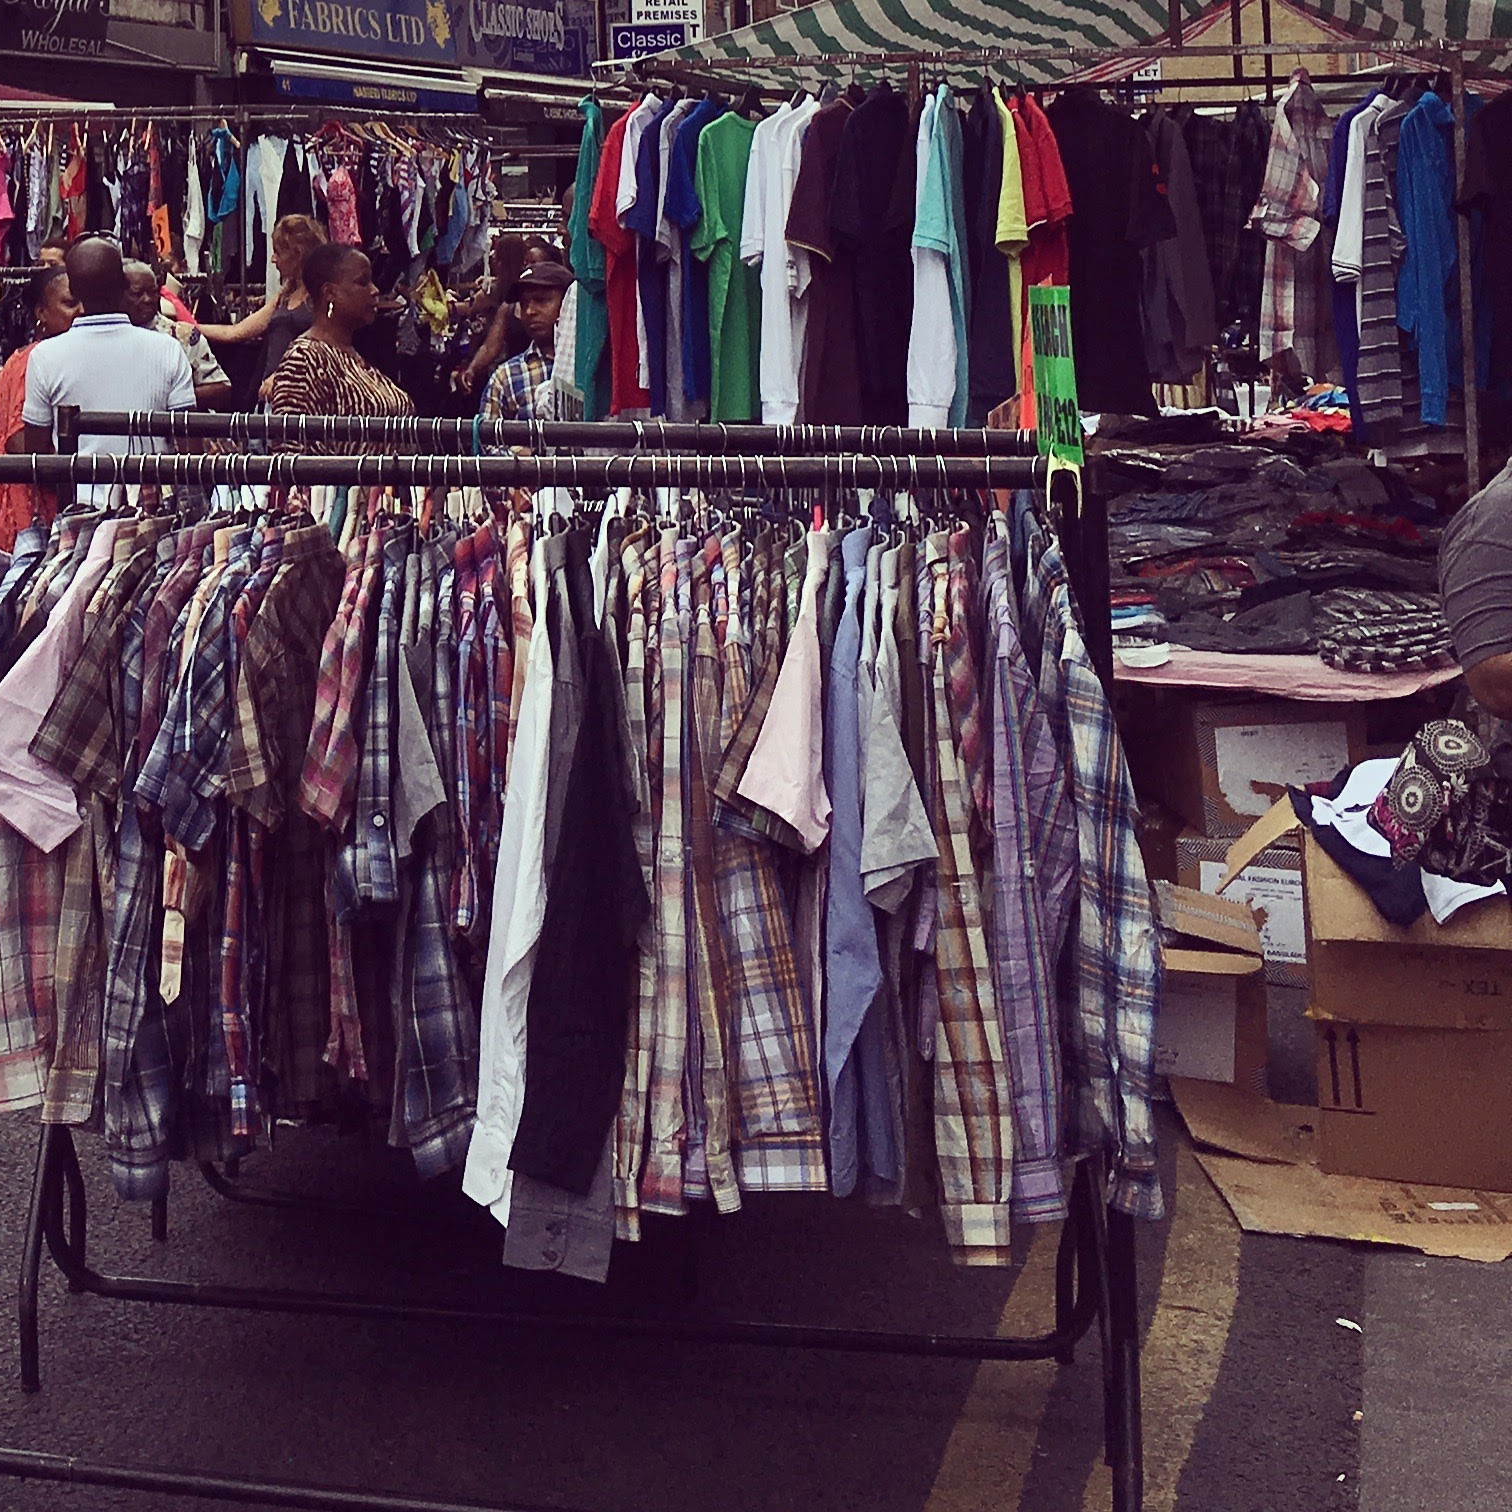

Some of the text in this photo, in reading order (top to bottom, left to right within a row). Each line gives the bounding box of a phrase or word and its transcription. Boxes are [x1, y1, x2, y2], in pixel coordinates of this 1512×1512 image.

[636, 9, 698, 21] PREMISES
[385, 11, 426, 46] LTD
[526, 0, 565, 52] SHOES
[20, 29, 104, 55] WHOLESAL
[617, 29, 681, 48] Classic
[1137, 68, 1159, 78] LET
[1280, 878, 1302, 887] EURO
